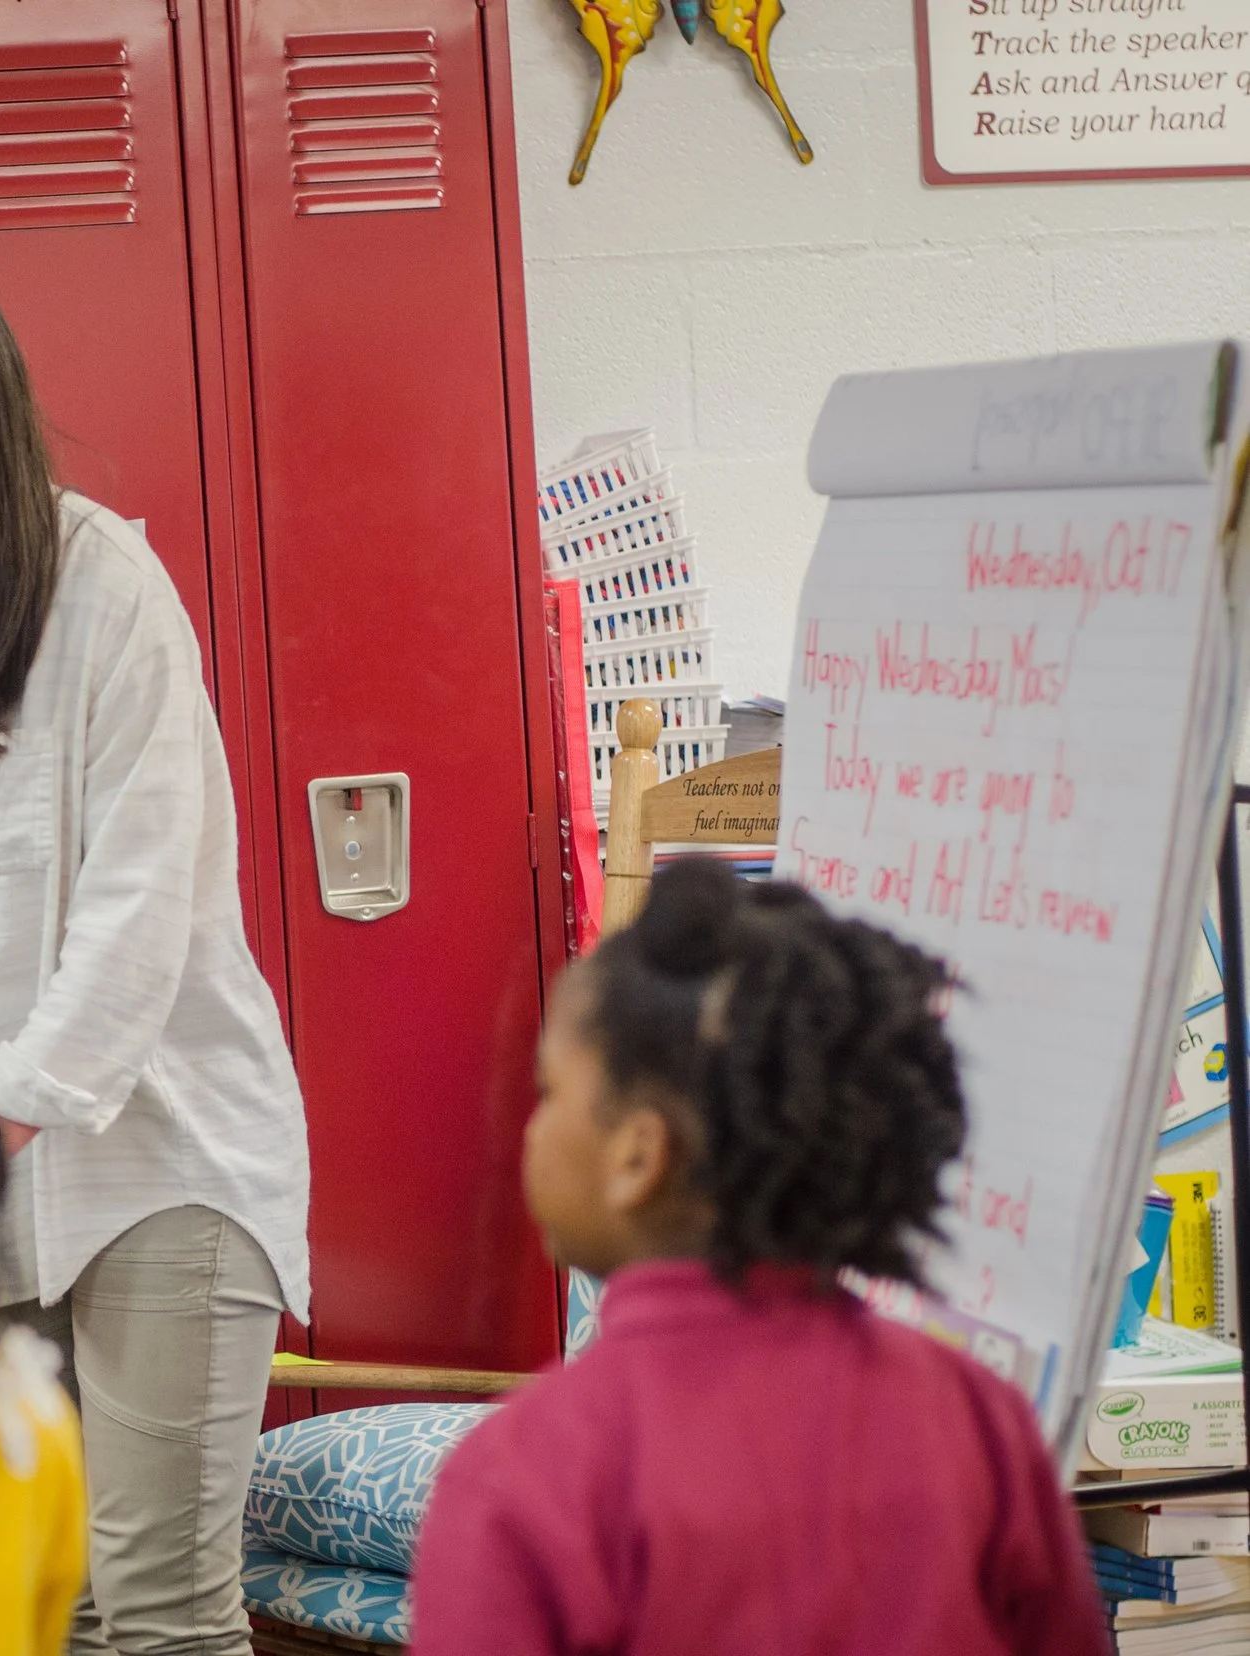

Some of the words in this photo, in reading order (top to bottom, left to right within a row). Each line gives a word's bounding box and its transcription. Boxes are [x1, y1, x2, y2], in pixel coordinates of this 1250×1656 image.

[1021, 0, 1057, 21] up
[971, 28, 1059, 56] Track
[1070, 27, 1116, 54] the
[1126, 24, 1250, 58] speaker
[970, 69, 1031, 96] Ask
[1041, 67, 1100, 95] and
[1109, 67, 1228, 93] Answer
[973, 109, 1060, 137] Raise
[1070, 113, 1140, 141] your
[1149, 104, 1227, 132] hand
[1158, 519, 1193, 597] 17
[802, 617, 869, 722] Happy
[682, 775, 739, 797] Teachers
[742, 780, 764, 797] not
[689, 809, 723, 837] fuel
[1173, 1024, 1204, 1058] ch
[1118, 1420, 1191, 1446] CRAYONS
